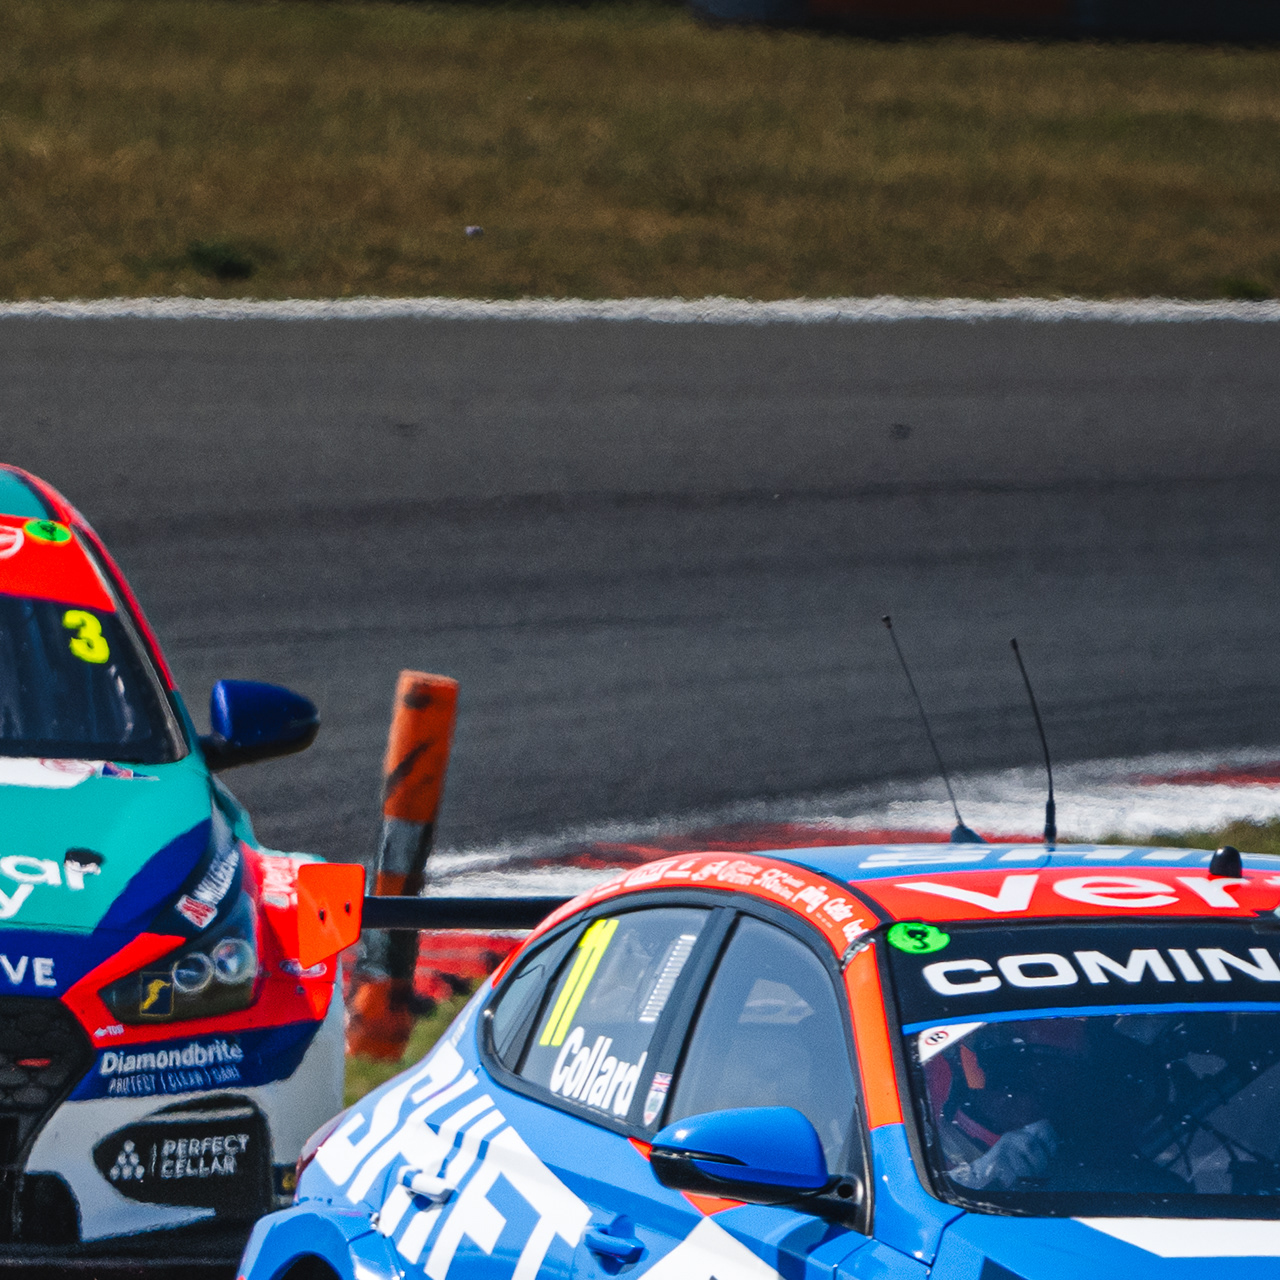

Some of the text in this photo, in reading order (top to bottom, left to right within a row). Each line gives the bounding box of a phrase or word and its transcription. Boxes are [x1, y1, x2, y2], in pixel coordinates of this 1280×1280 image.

[62, 609, 109, 663] 3
[539, 918, 620, 1047] 11
[100, 1038, 245, 1076] Diamondbrite
[549, 1025, 649, 1117] Collard
[161, 1133, 250, 1157] PERFECT
[161, 1155, 237, 1179] CELLAR
